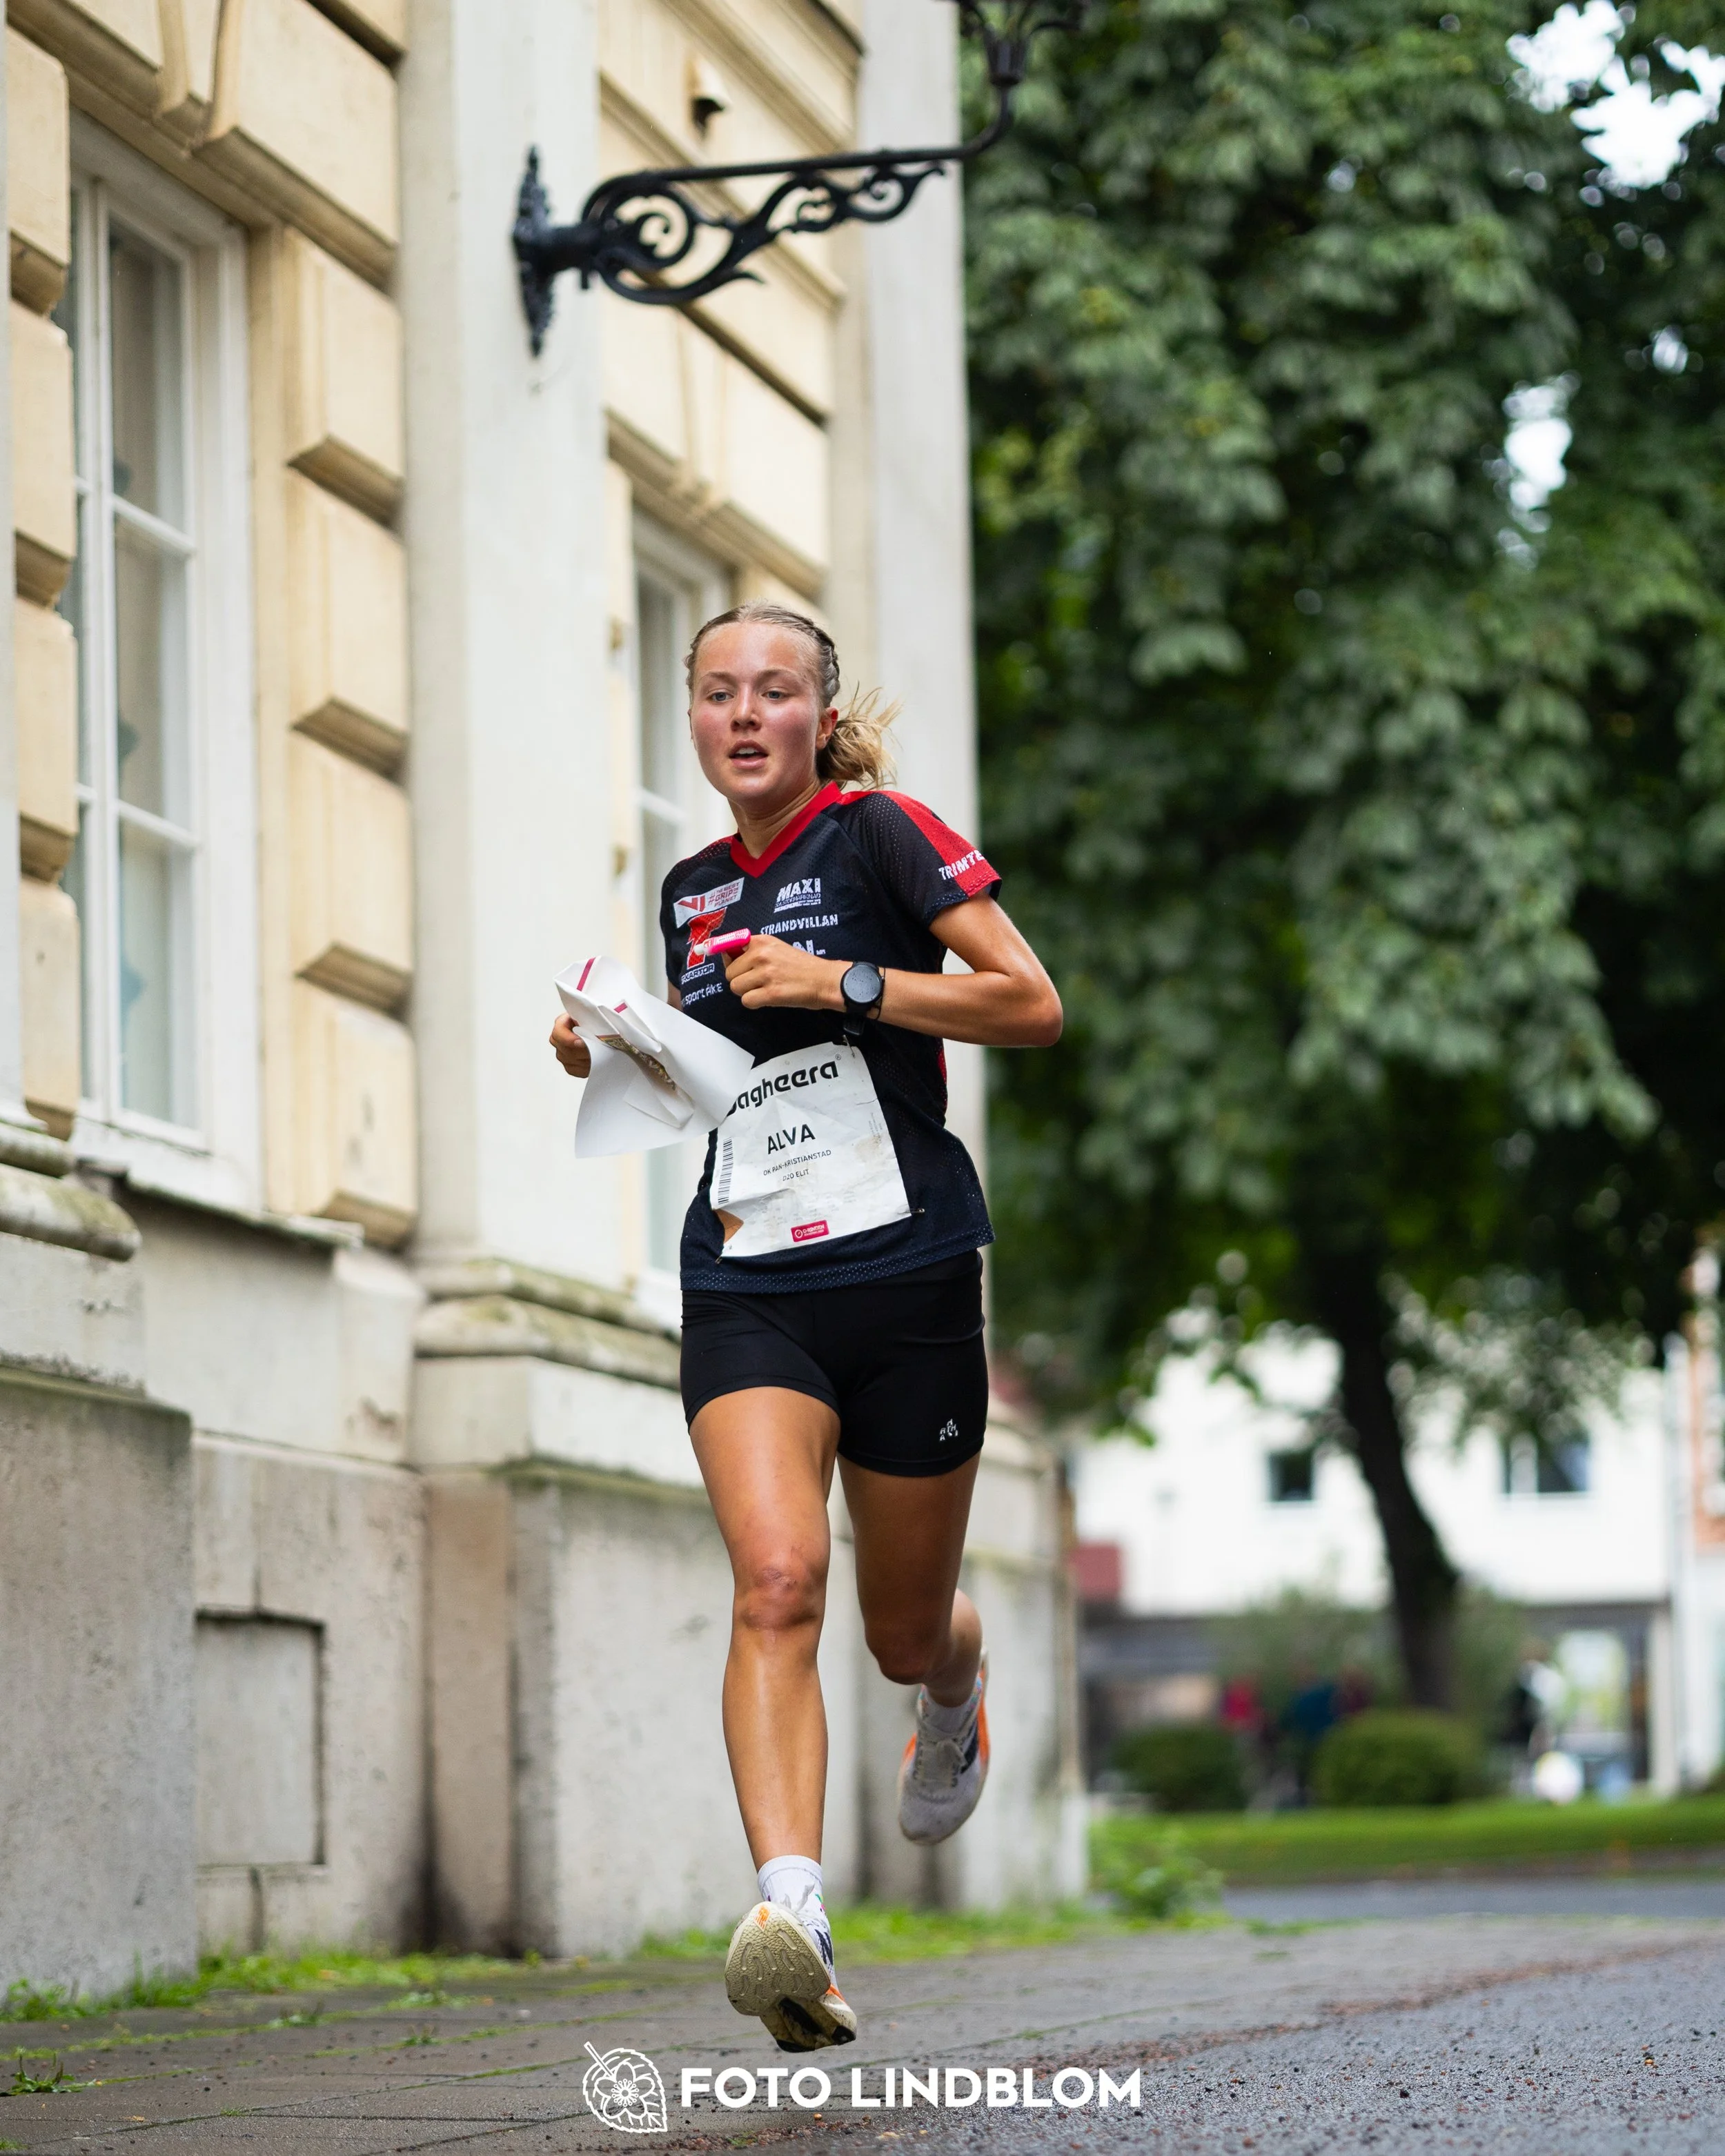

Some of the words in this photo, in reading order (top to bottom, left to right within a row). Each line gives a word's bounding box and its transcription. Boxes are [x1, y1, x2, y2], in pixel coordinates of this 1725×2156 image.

[776, 878, 821, 902] MAXI
[767, 1124, 816, 1154] ALVA
[763, 1167, 771, 1176] OK
[772, 1149, 831, 1173] PAN-KRISTIANSTAD
[782, 1172, 794, 1181] D20
[796, 1169, 809, 1178] ELIT
